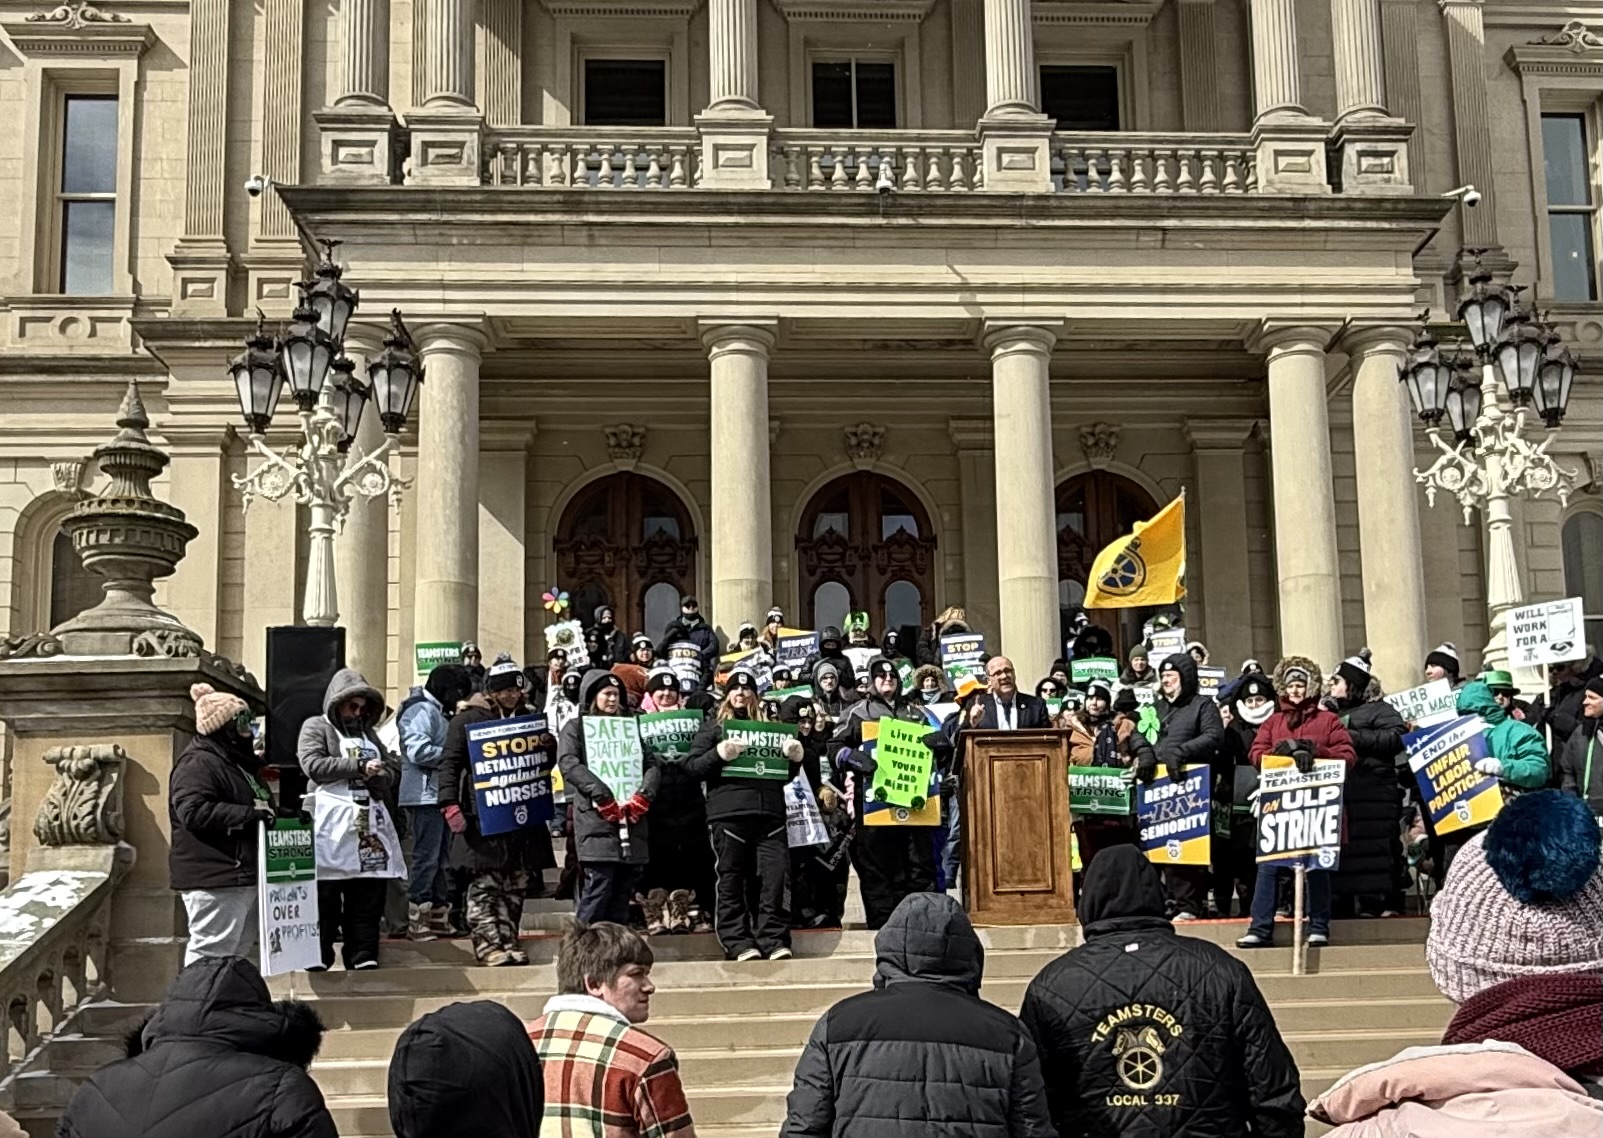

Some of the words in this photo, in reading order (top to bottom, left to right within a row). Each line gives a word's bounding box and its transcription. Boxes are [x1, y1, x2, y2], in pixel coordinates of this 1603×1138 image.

[1514, 608, 1544, 620] WILL
[1512, 620, 1547, 634] WORK
[947, 642, 979, 653] STOP
[1516, 636, 1537, 648] FOR
[1540, 634, 1548, 644] A
[1390, 688, 1428, 708] NLRB
[584, 718, 635, 740] SAFE
[640, 718, 700, 738] EAMSTERS
[482, 734, 540, 758] STOP
[642, 732, 696, 746] TRON
[588, 740, 639, 760] STAFFING
[884, 744, 930, 760] MATTER!
[1422, 740, 1446, 760] END
[475, 751, 547, 775] RETALIATING
[590, 759, 640, 778] SAVES
[892, 760, 923, 774] YOURS
[1426, 744, 1471, 780] UNFAIR
[490, 766, 540, 788] against
[898, 773, 917, 783] AND
[1264, 770, 1340, 788] TEAMSTERS
[1432, 760, 1472, 794] LABOR
[485, 780, 550, 806] NURSES.
[1144, 776, 1202, 804] RESPECT
[1282, 785, 1340, 810] ULP
[1262, 798, 1280, 814] ON
[1140, 812, 1208, 841] SENIORITY
[1260, 804, 1340, 853] STRIKE
[268, 830, 312, 846] TEAMSTERS
[269, 847, 312, 859] STRONG
[273, 904, 300, 921] OVER
[1091, 1003, 1184, 1043] TEAMSTERS
[1106, 1094, 1148, 1106] LOCAL
[1155, 1094, 1180, 1106] 337
